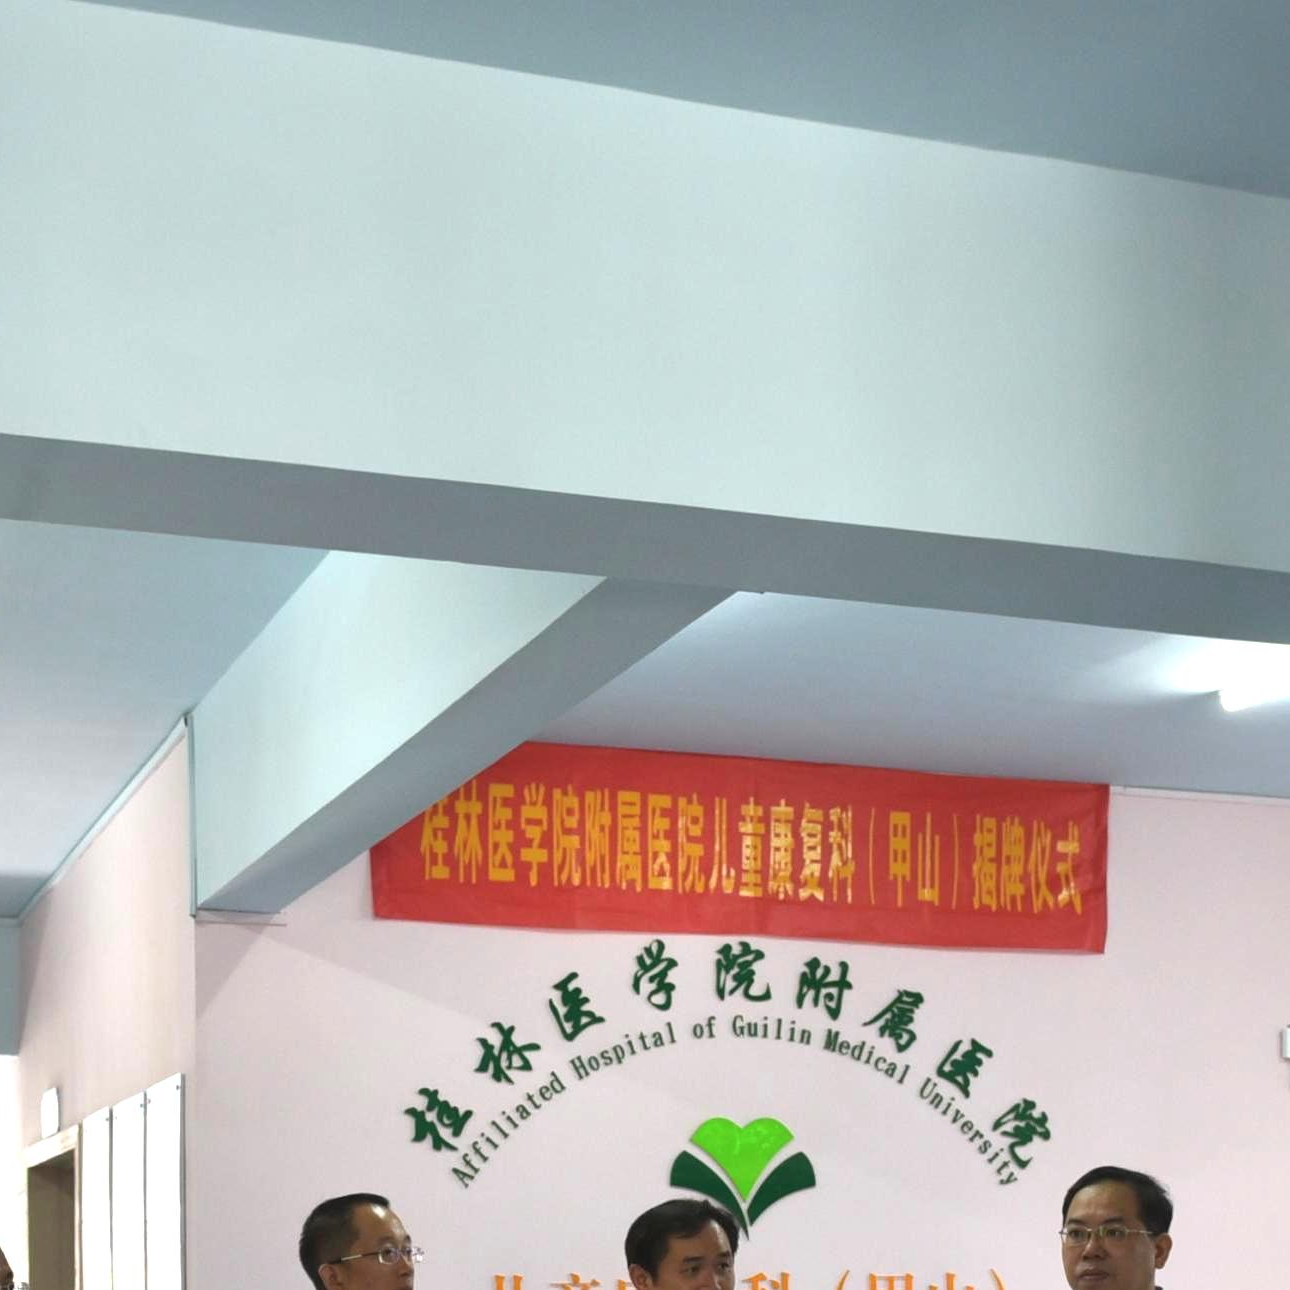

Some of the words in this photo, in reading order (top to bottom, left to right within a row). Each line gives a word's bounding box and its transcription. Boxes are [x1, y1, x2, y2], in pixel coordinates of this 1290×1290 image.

[451, 1071, 567, 1189] Affiliated
[570, 1021, 677, 1081] Hospital
[693, 1016, 717, 1039] of
[732, 1015, 812, 1045] Guilin
[823, 1028, 911, 1085] Medical
[919, 1077, 1019, 1187] University
